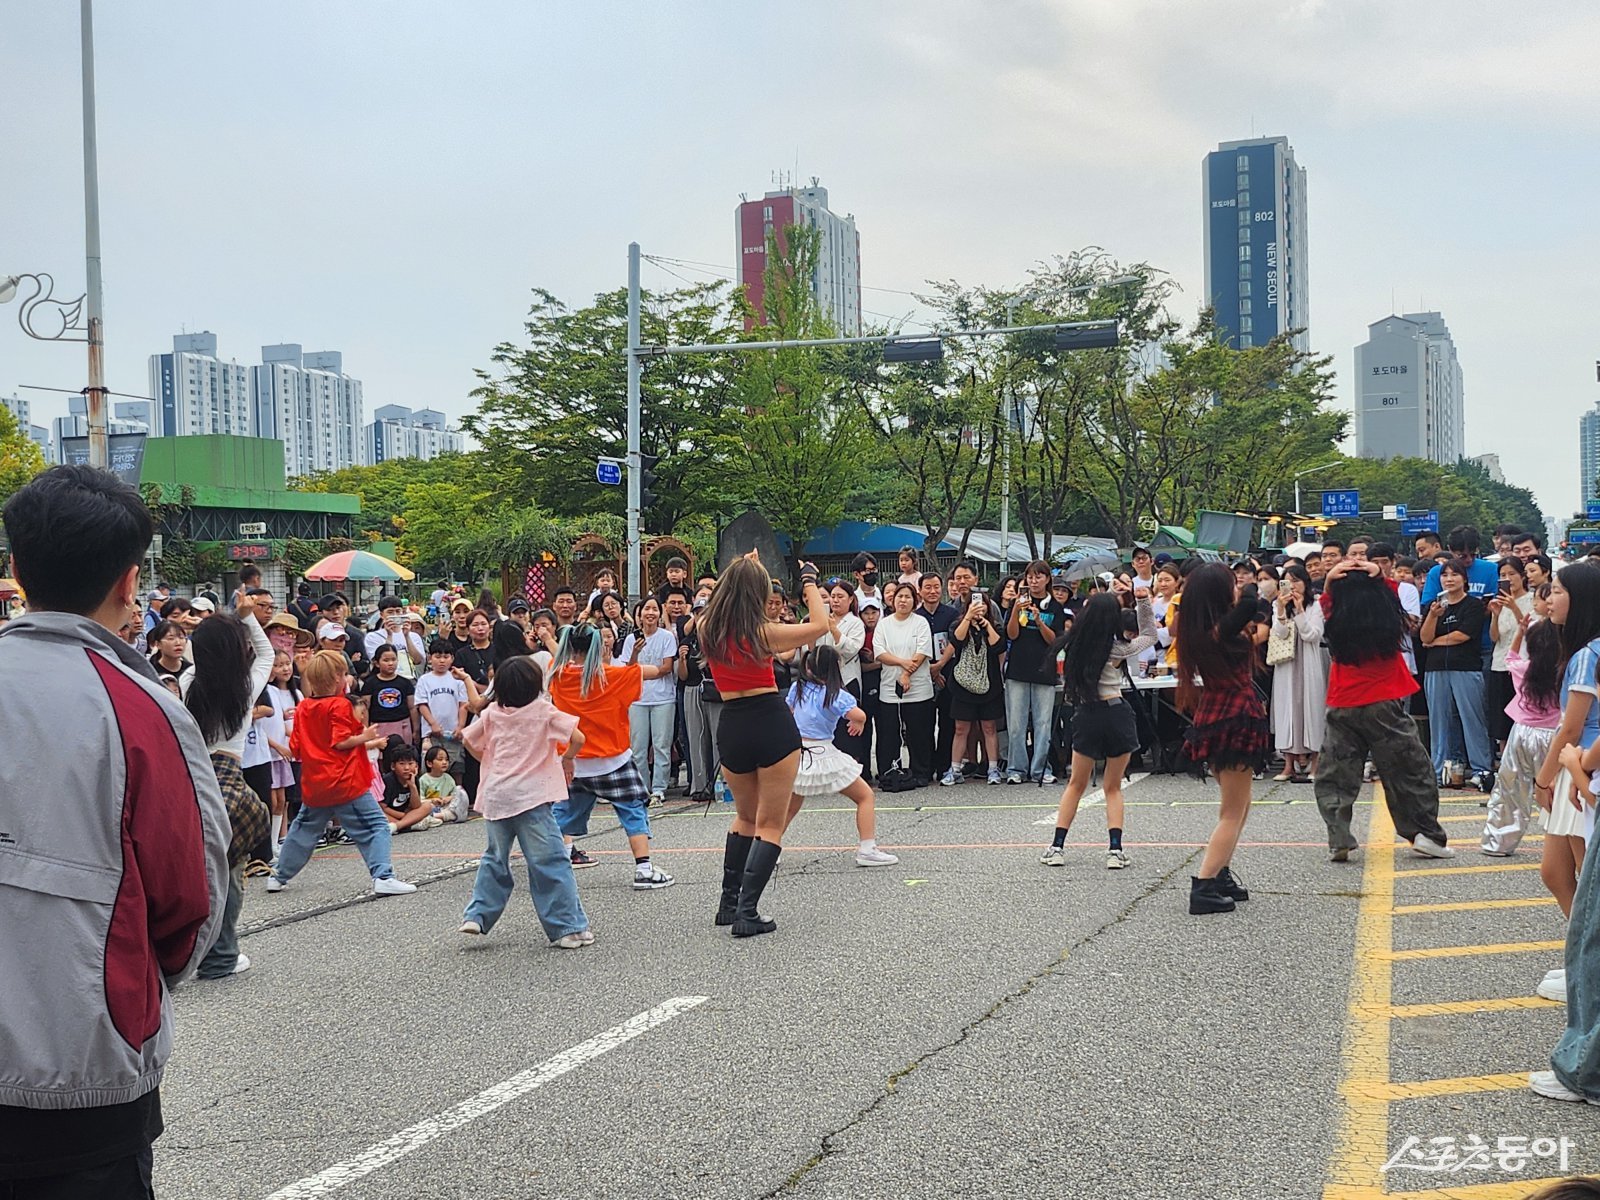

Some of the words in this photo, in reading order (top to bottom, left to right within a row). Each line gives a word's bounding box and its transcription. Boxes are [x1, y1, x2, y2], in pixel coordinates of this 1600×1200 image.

[1254, 211, 1274, 222] 802
[1266, 242, 1277, 268] NEW
[1266, 270, 1278, 309] SEOUL
[1371, 365, 1408, 376] 포도마을
[1382, 397, 1399, 406] 801
